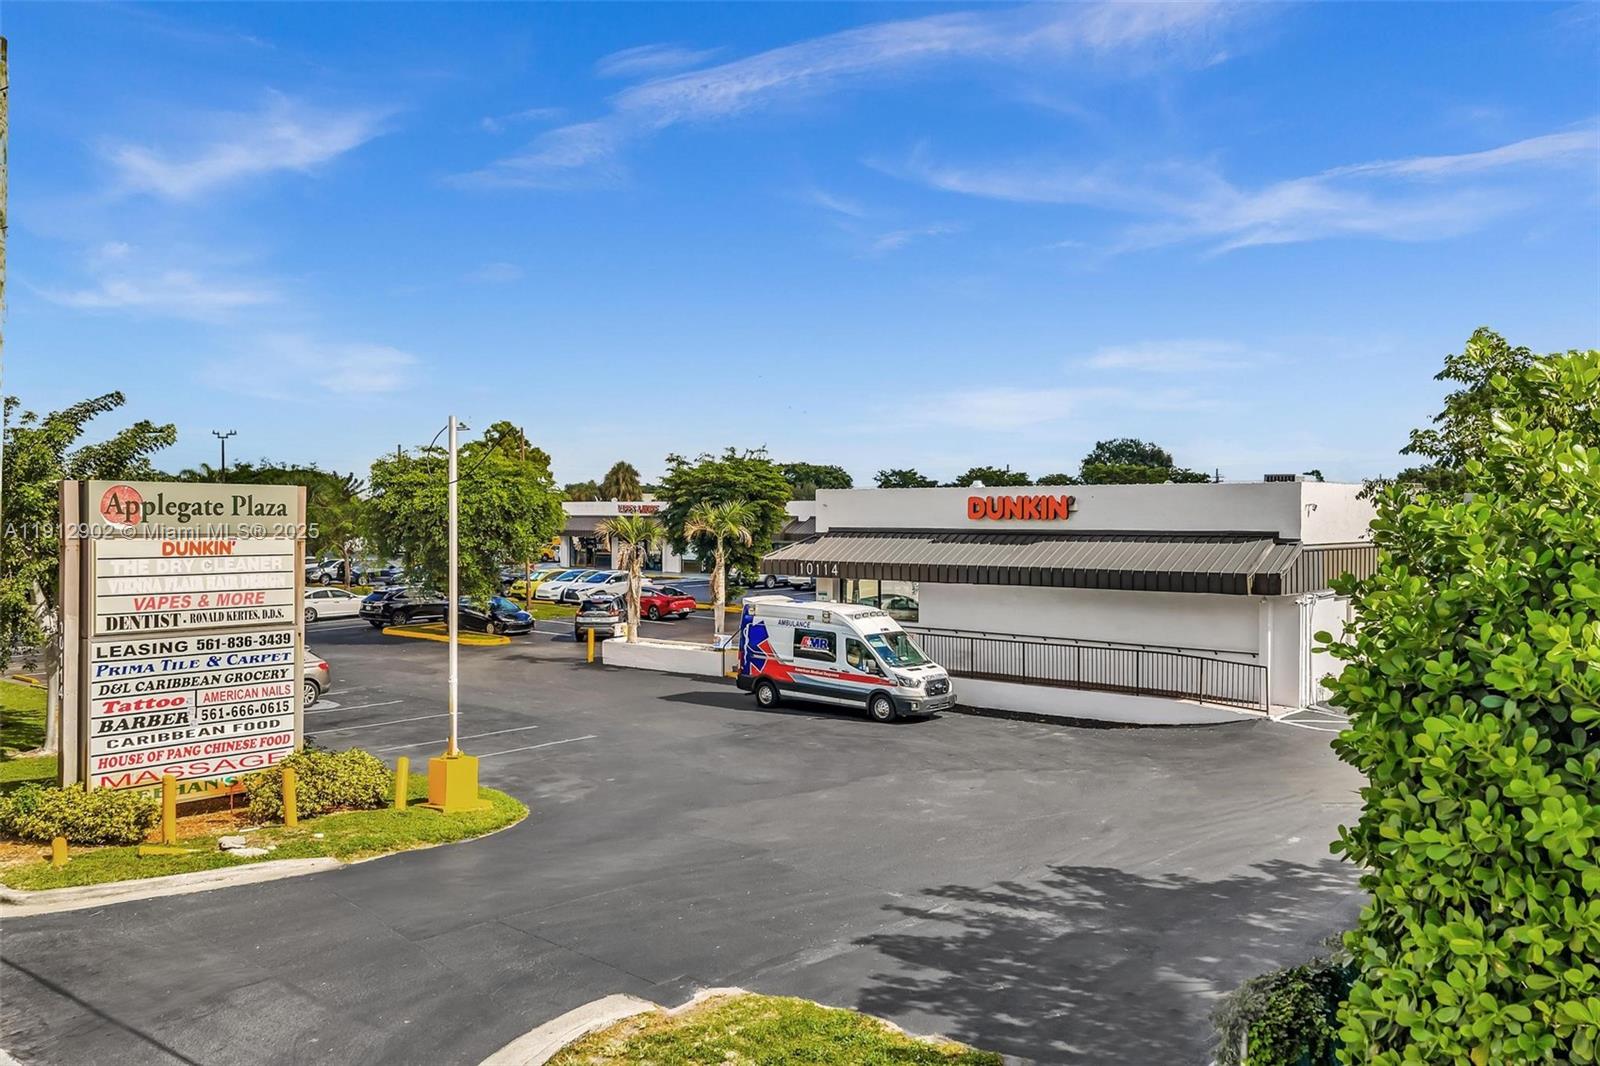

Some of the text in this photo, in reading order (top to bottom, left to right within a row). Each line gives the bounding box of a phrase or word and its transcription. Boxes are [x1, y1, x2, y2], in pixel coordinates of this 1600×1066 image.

[104, 491, 288, 525] Applegate Plaza
[162, 540, 236, 556] DUNKIN'
[110, 557, 283, 576] THE DRY CLEANER
[799, 563, 839, 575] 10114
[133, 592, 266, 611] VAPES & MORE
[190, 611, 224, 624] RONALD
[262, 608, 285, 619] D.D.S.
[778, 619, 811, 628] AMBULANCE
[96, 633, 291, 658] LEASING 561-836-3439
[96, 652, 291, 677] PRIMA TILE & CARPET
[98, 668, 289, 696] D&L CARIBBEAN GROCERY
[203, 684, 291, 703] AMERICAN NAILS
[102, 697, 185, 714] Tattoo
[201, 701, 289, 721] 561-666-0615
[97, 712, 189, 733] BARBER
[106, 720, 280, 749] CARIBBEAN FOOD
[98, 734, 291, 770] HOUSE OF PANG CHINESE FOOD
[100, 751, 287, 787] MASSAGE
